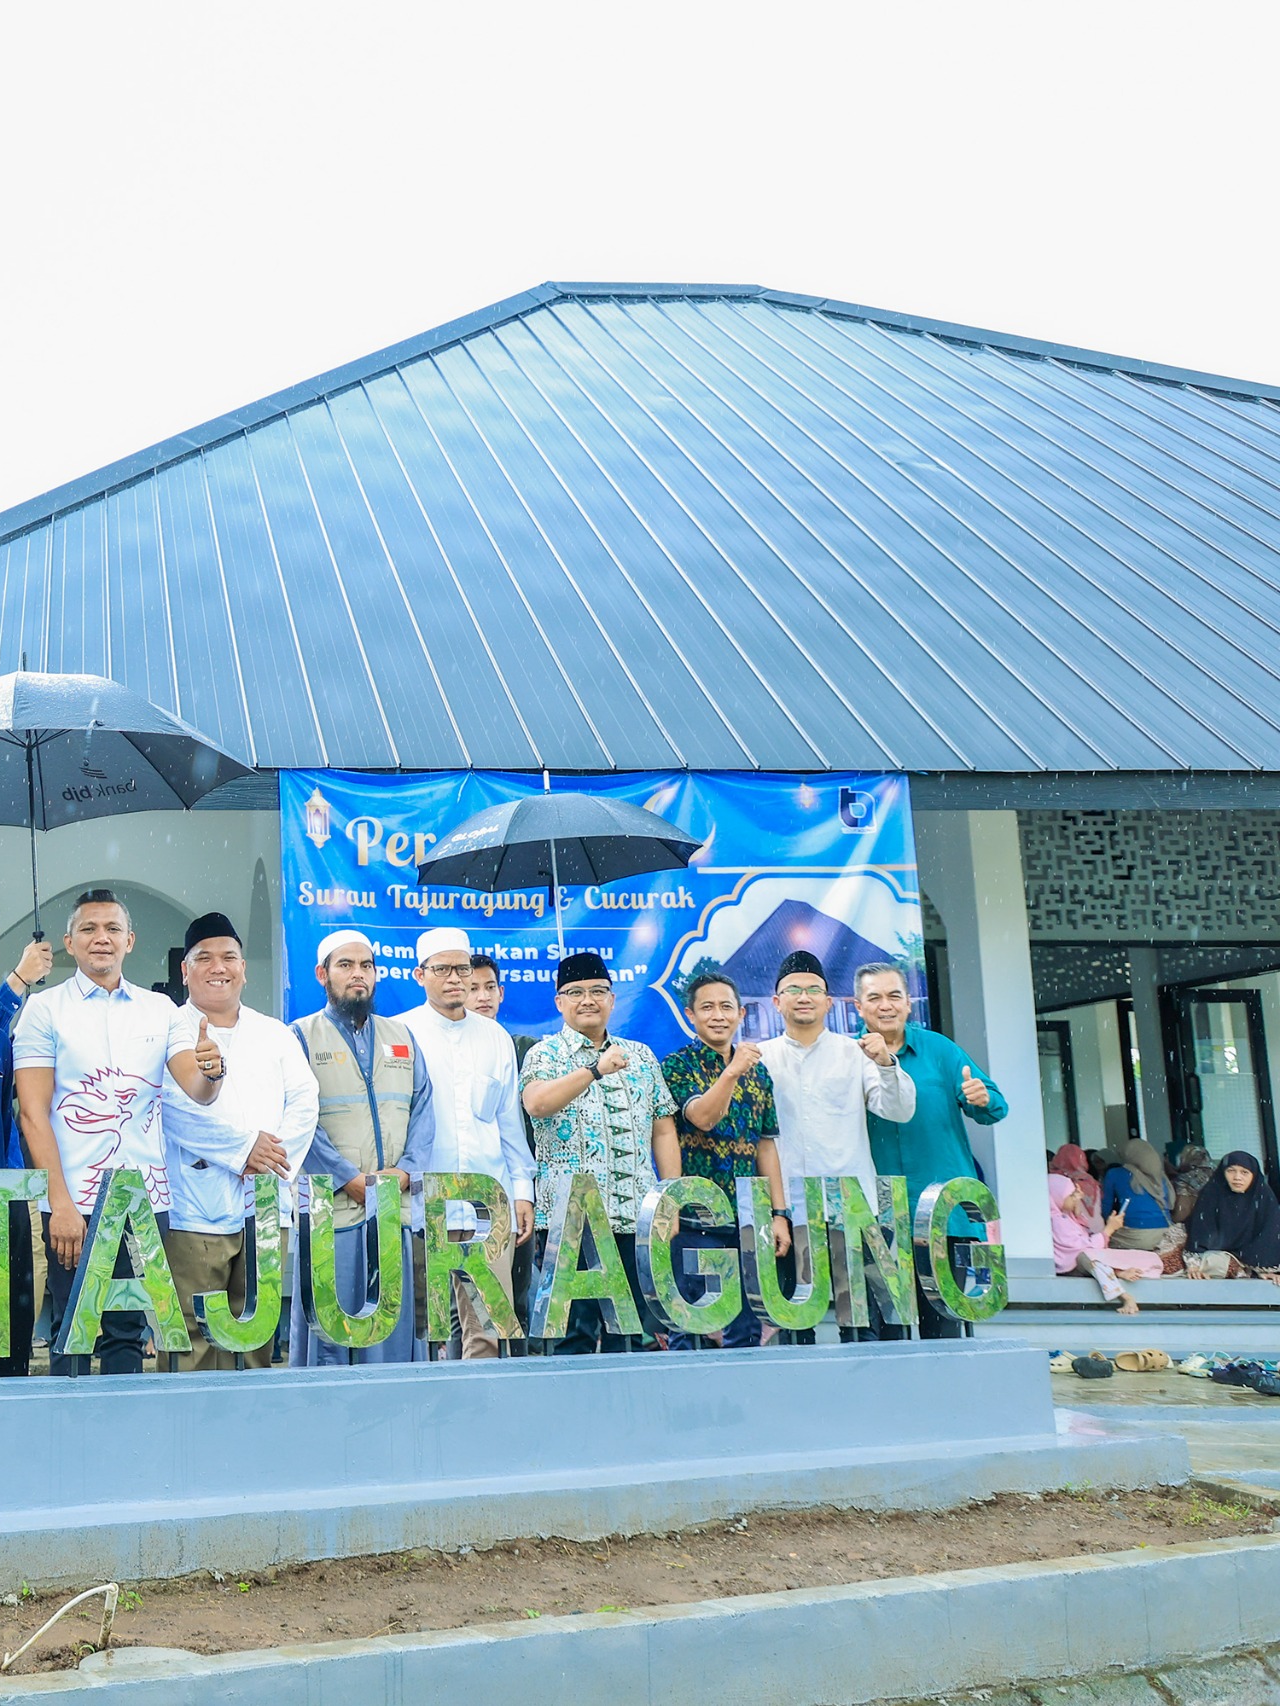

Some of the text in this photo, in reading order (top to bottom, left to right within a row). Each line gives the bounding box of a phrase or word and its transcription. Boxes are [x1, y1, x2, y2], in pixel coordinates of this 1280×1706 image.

[298, 881, 377, 908] Surau
[386, 884, 545, 918] Tajuragung
[584, 885, 696, 910] Cucurak
